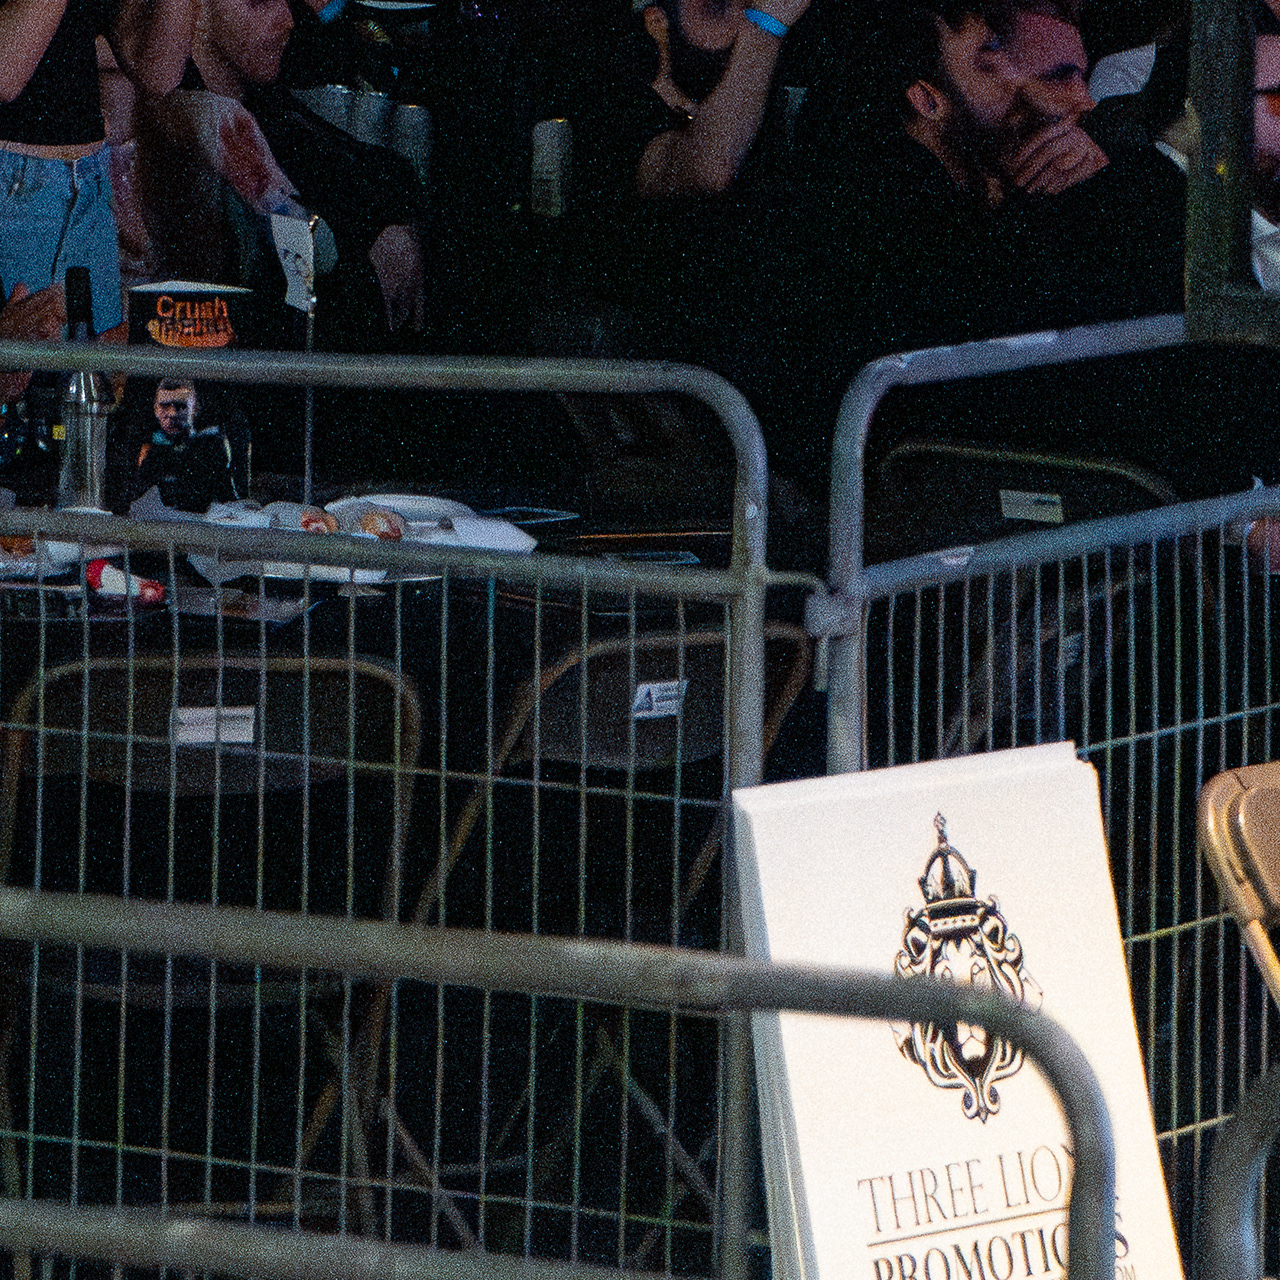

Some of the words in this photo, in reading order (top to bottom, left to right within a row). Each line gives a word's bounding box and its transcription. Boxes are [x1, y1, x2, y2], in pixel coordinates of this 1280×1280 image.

[155, 294, 230, 320] Crush
[857, 1158, 990, 1233] THREE
[997, 1143, 1076, 1209] LIO
